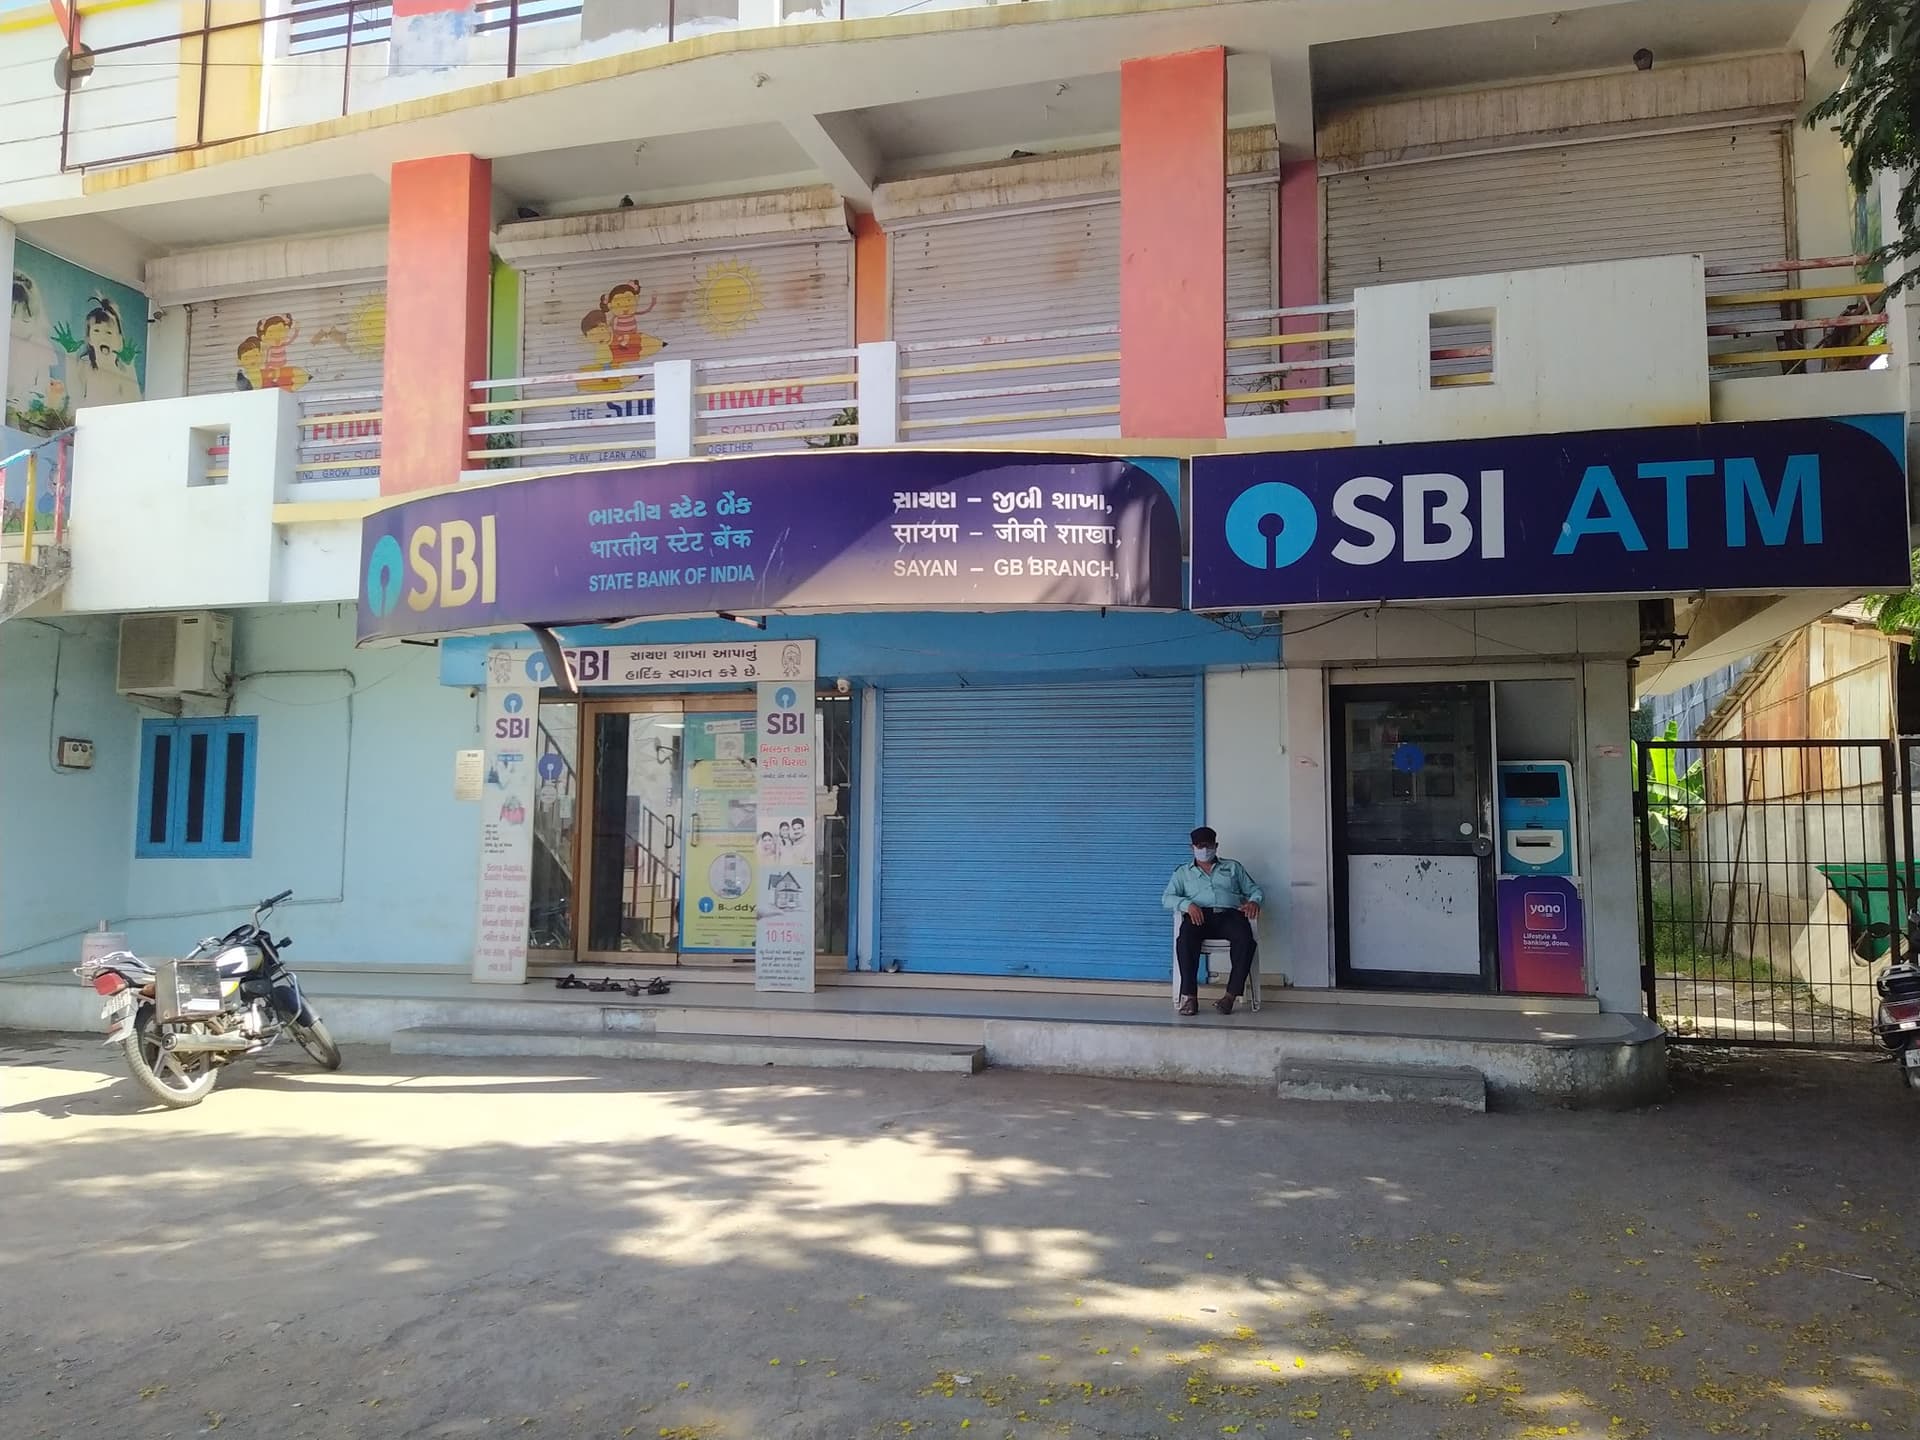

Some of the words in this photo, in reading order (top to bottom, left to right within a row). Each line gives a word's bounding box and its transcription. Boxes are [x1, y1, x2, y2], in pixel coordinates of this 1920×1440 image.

[570, 408, 593, 420] THE
[588, 500, 661, 526] ભારતીય
[670, 494, 707, 519] સ્ટેટ
[892, 491, 956, 509] સાયણ
[992, 486, 1042, 513] જીબી
[1052, 492, 1113, 514] શાખા,
[1331, 469, 1505, 565] SBI
[1553, 454, 1823, 555] ATM
[590, 531, 659, 559] भारतीय
[665, 526, 704, 553] स्टेट
[891, 523, 959, 544] सायण
[992, 517, 1048, 543] जीबी
[1054, 524, 1121, 549] शाखा,
[407, 514, 497, 612] SBI
[894, 559, 957, 577] SAYAN
[994, 558, 1023, 576] GB
[1030, 559, 1119, 579] BRANCH,
[589, 572, 633, 592] STATE
[637, 569, 680, 588] BANK
[685, 567, 706, 585] OF
[711, 564, 754, 583] INDIA
[630, 650, 667, 661] સાયણ
[673, 649, 706, 659] શાખા
[625, 666, 662, 680] હાર્દિક
[668, 669, 712, 679] સ્વાગત
[719, 664, 738, 677] કરે
[495, 718, 530, 739] SBI
[767, 713, 805, 735] SBI
[1530, 904, 1561, 915] yono
